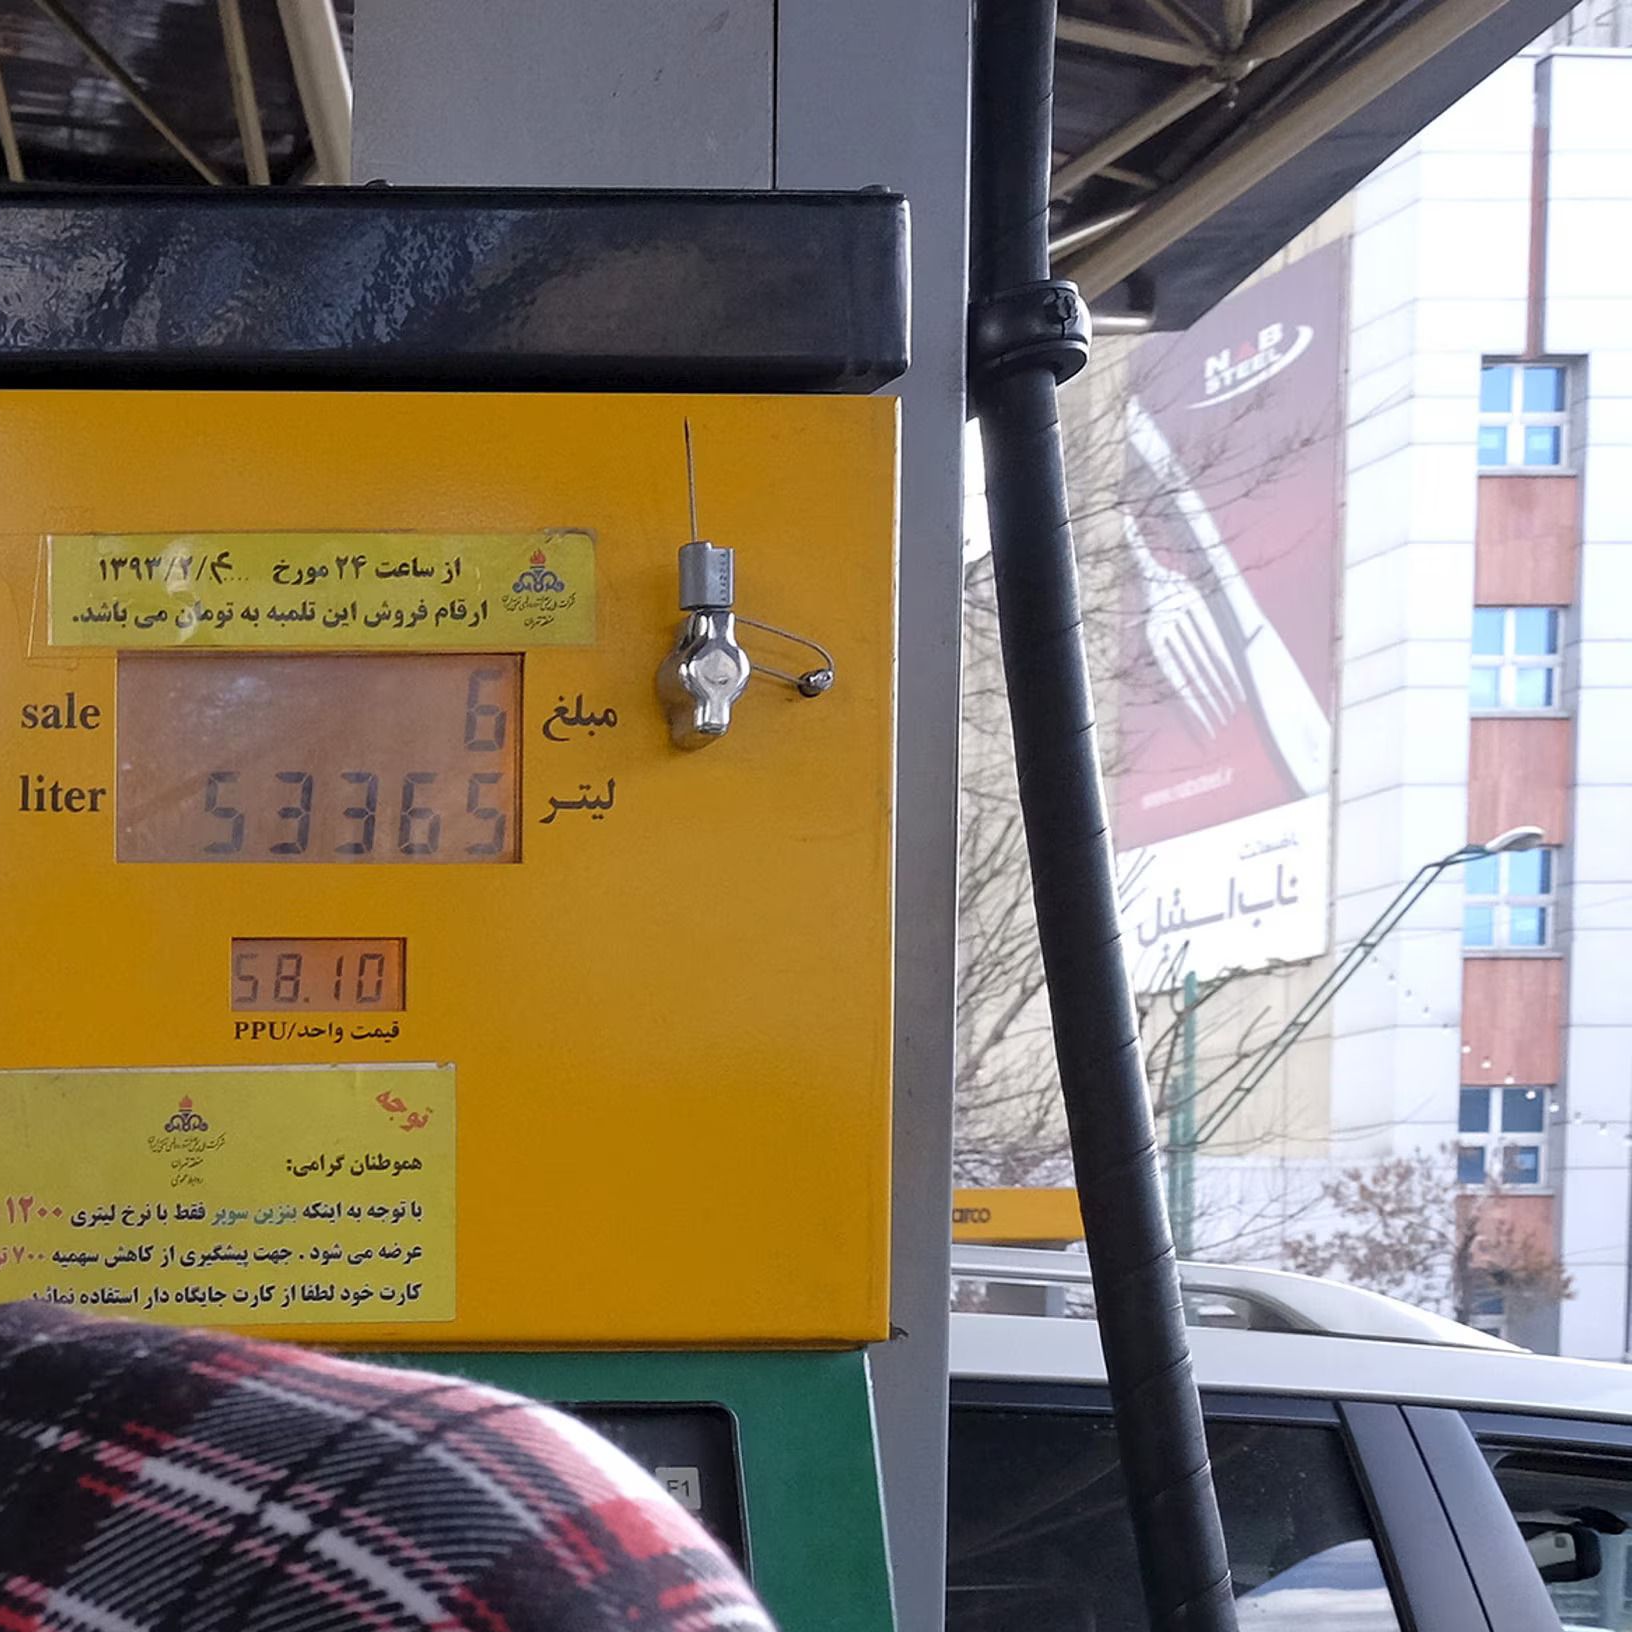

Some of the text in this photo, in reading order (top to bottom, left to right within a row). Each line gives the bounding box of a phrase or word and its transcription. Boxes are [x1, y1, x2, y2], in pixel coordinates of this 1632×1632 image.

[1205, 348, 1283, 394] STEEL
[272, 555, 329, 584] مورخ
[335, 555, 367, 580] ۲۴
[375, 554, 434, 581] ساعت
[440, 555, 461, 583] از
[72, 601, 128, 628] باشد.
[134, 604, 170, 630] می
[175, 601, 233, 630] تومان
[239, 605, 261, 627] به
[265, 601, 316, 627] تلمبه
[321, 600, 358, 628] این
[363, 601, 428, 630] فروش
[434, 600, 488, 630] ارقام
[20, 692, 101, 732] sale
[462, 667, 507, 753] 6
[540, 692, 618, 740] مبلغ
[18, 774, 106, 815] liter
[538, 776, 616, 823] لیتر
[204, 770, 507, 857] 53365
[1136, 863, 1299, 960] ناب استیل
[235, 952, 387, 1004] 58.10
[351, 1019, 401, 1043] قیمت
[376, 1089, 435, 1132] توجه
[285, 1152, 422, 1177] هموطنان گرامی:
[70, 1203, 116, 1228] لیتری
[121, 1203, 152, 1227] نرخ
[156, 1204, 168, 1222] با
[173, 1201, 206, 1221] فقط
[211, 1204, 249, 1226] سوپر
[253, 1203, 297, 1225] بنزین
[302, 1201, 341, 1223] اینکه
[346, 1204, 362, 1223] به
[366, 1200, 406, 1223] توجه
[410, 1200, 423, 1222] با
[52, 1249, 99, 1268] سهمیه
[104, 1244, 154, 1268] کاهش
[159, 1245, 175, 1268] از
[179, 1244, 249, 1268] پیشگیری
[252, 1245, 293, 1266] جهت
[346, 1248, 373, 1266] می
[379, 1242, 423, 1265] عرضه
[79, 1286, 138, 1306] استفاده
[144, 1286, 170, 1309] دار
[174, 1285, 227, 1308] جایگاه
[232, 1284, 276, 1308] کارت
[281, 1285, 296, 1308] از
[301, 1284, 335, 1303] لطفا
[340, 1284, 374, 1308] خود
[379, 1283, 423, 1306] کارت
